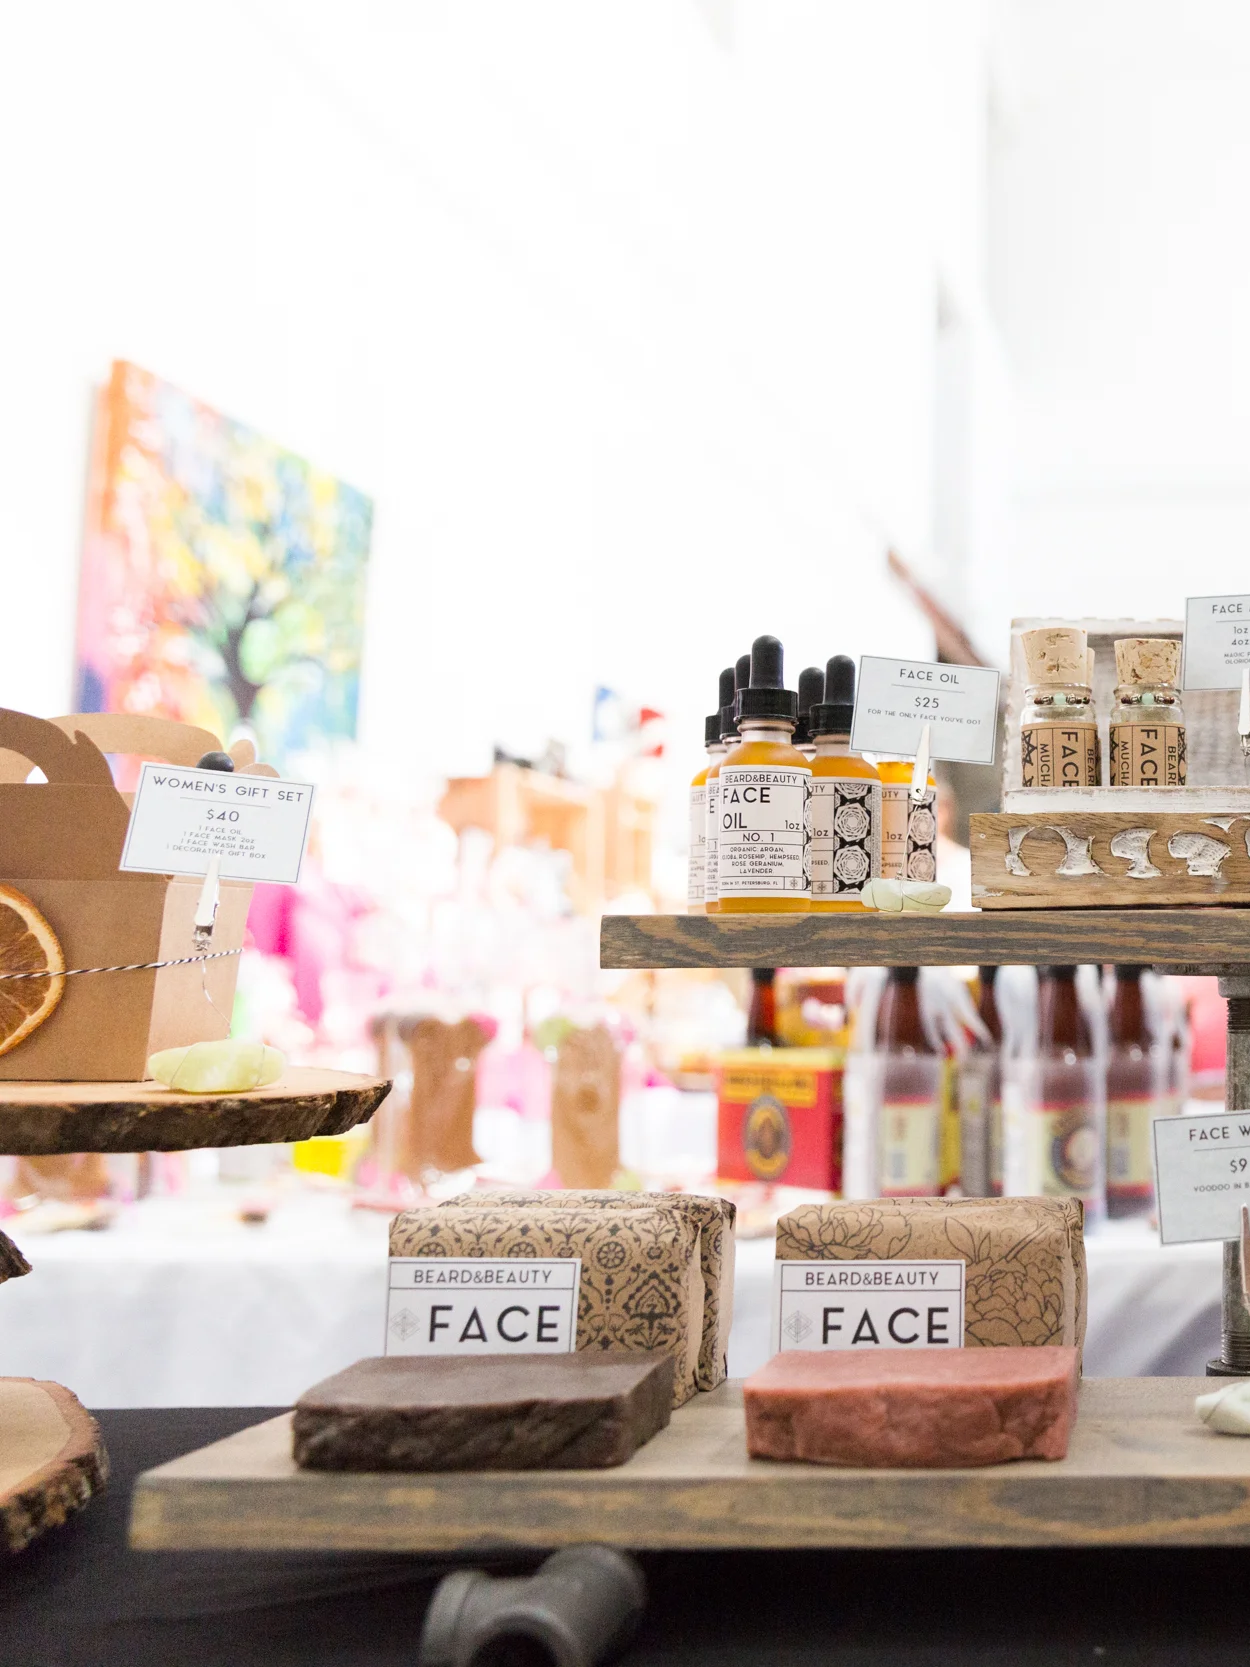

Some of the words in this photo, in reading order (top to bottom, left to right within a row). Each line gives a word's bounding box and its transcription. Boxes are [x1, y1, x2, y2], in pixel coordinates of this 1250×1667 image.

[1212, 604, 1242, 614] FACE
[900, 669, 933, 681] FACE
[940, 674, 959, 684] OIL
[915, 697, 939, 708] $25
[725, 774, 797, 784] BEARD&BEAUTY
[153, 776, 226, 793] WOMEN'S
[236, 786, 269, 798] GIFT
[278, 791, 303, 802] SET
[723, 787, 770, 804] FACE
[207, 809, 240, 822] $40
[723, 813, 747, 829] OIL
[785, 820, 799, 830] 1oz
[743, 833, 764, 842] NO.
[771, 833, 774, 842] 1
[813, 828, 828, 836] 1oz
[887, 832, 902, 840] 1oz
[173, 845, 224, 855] DECORATIVE
[1189, 1127, 1230, 1141] FACE
[1230, 1158, 1247, 1173] $9
[1194, 1184, 1230, 1192] VOODOO
[414, 1269, 551, 1283] BEARD&BEAUTY
[805, 1272, 938, 1285] BEARD&BEAUTY
[429, 1305, 560, 1342] FACE
[822, 1307, 948, 1344] FACE
